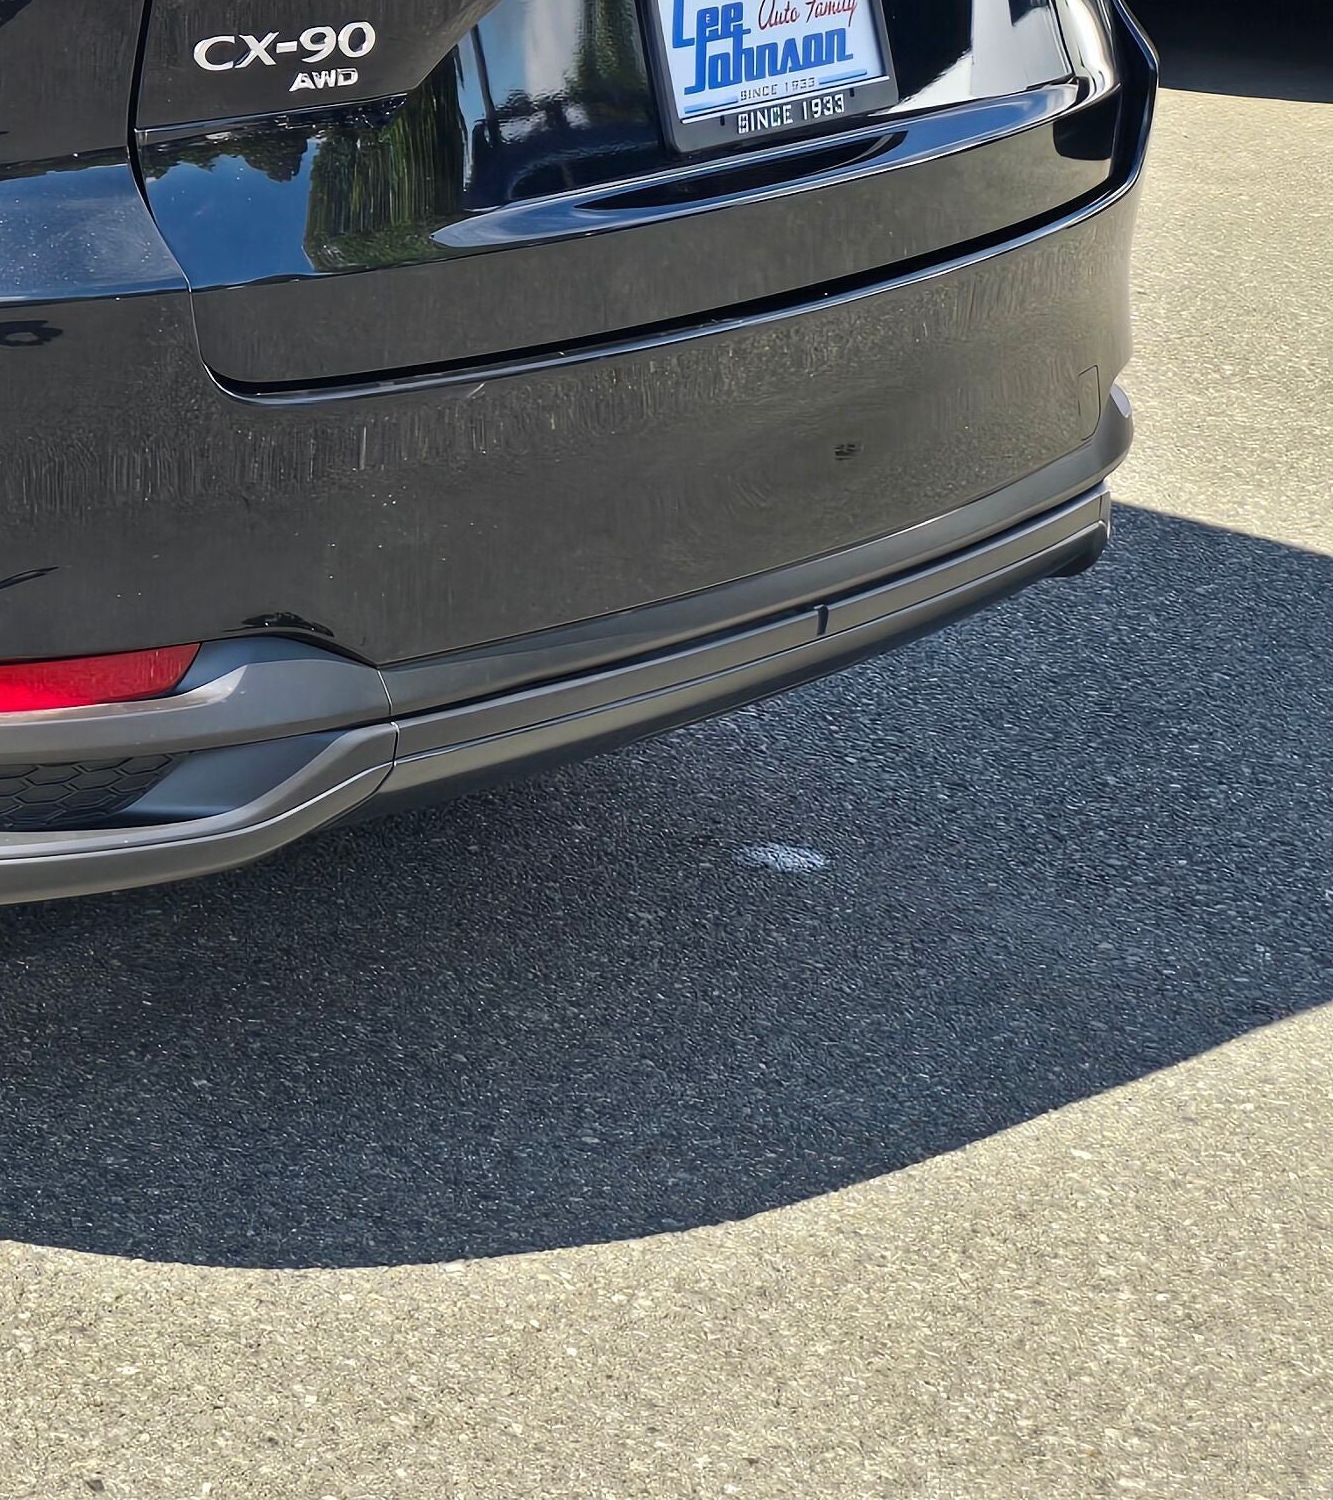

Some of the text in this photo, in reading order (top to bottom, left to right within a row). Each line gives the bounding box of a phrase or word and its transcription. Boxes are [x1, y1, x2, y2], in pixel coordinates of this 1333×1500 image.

[193, 21, 376, 71] CX-90
[684, 26, 854, 95] Johnson
[289, 67, 359, 92] AWD
[739, 77, 816, 101] SINCE 1933
[737, 93, 846, 135] SINCE 1933
